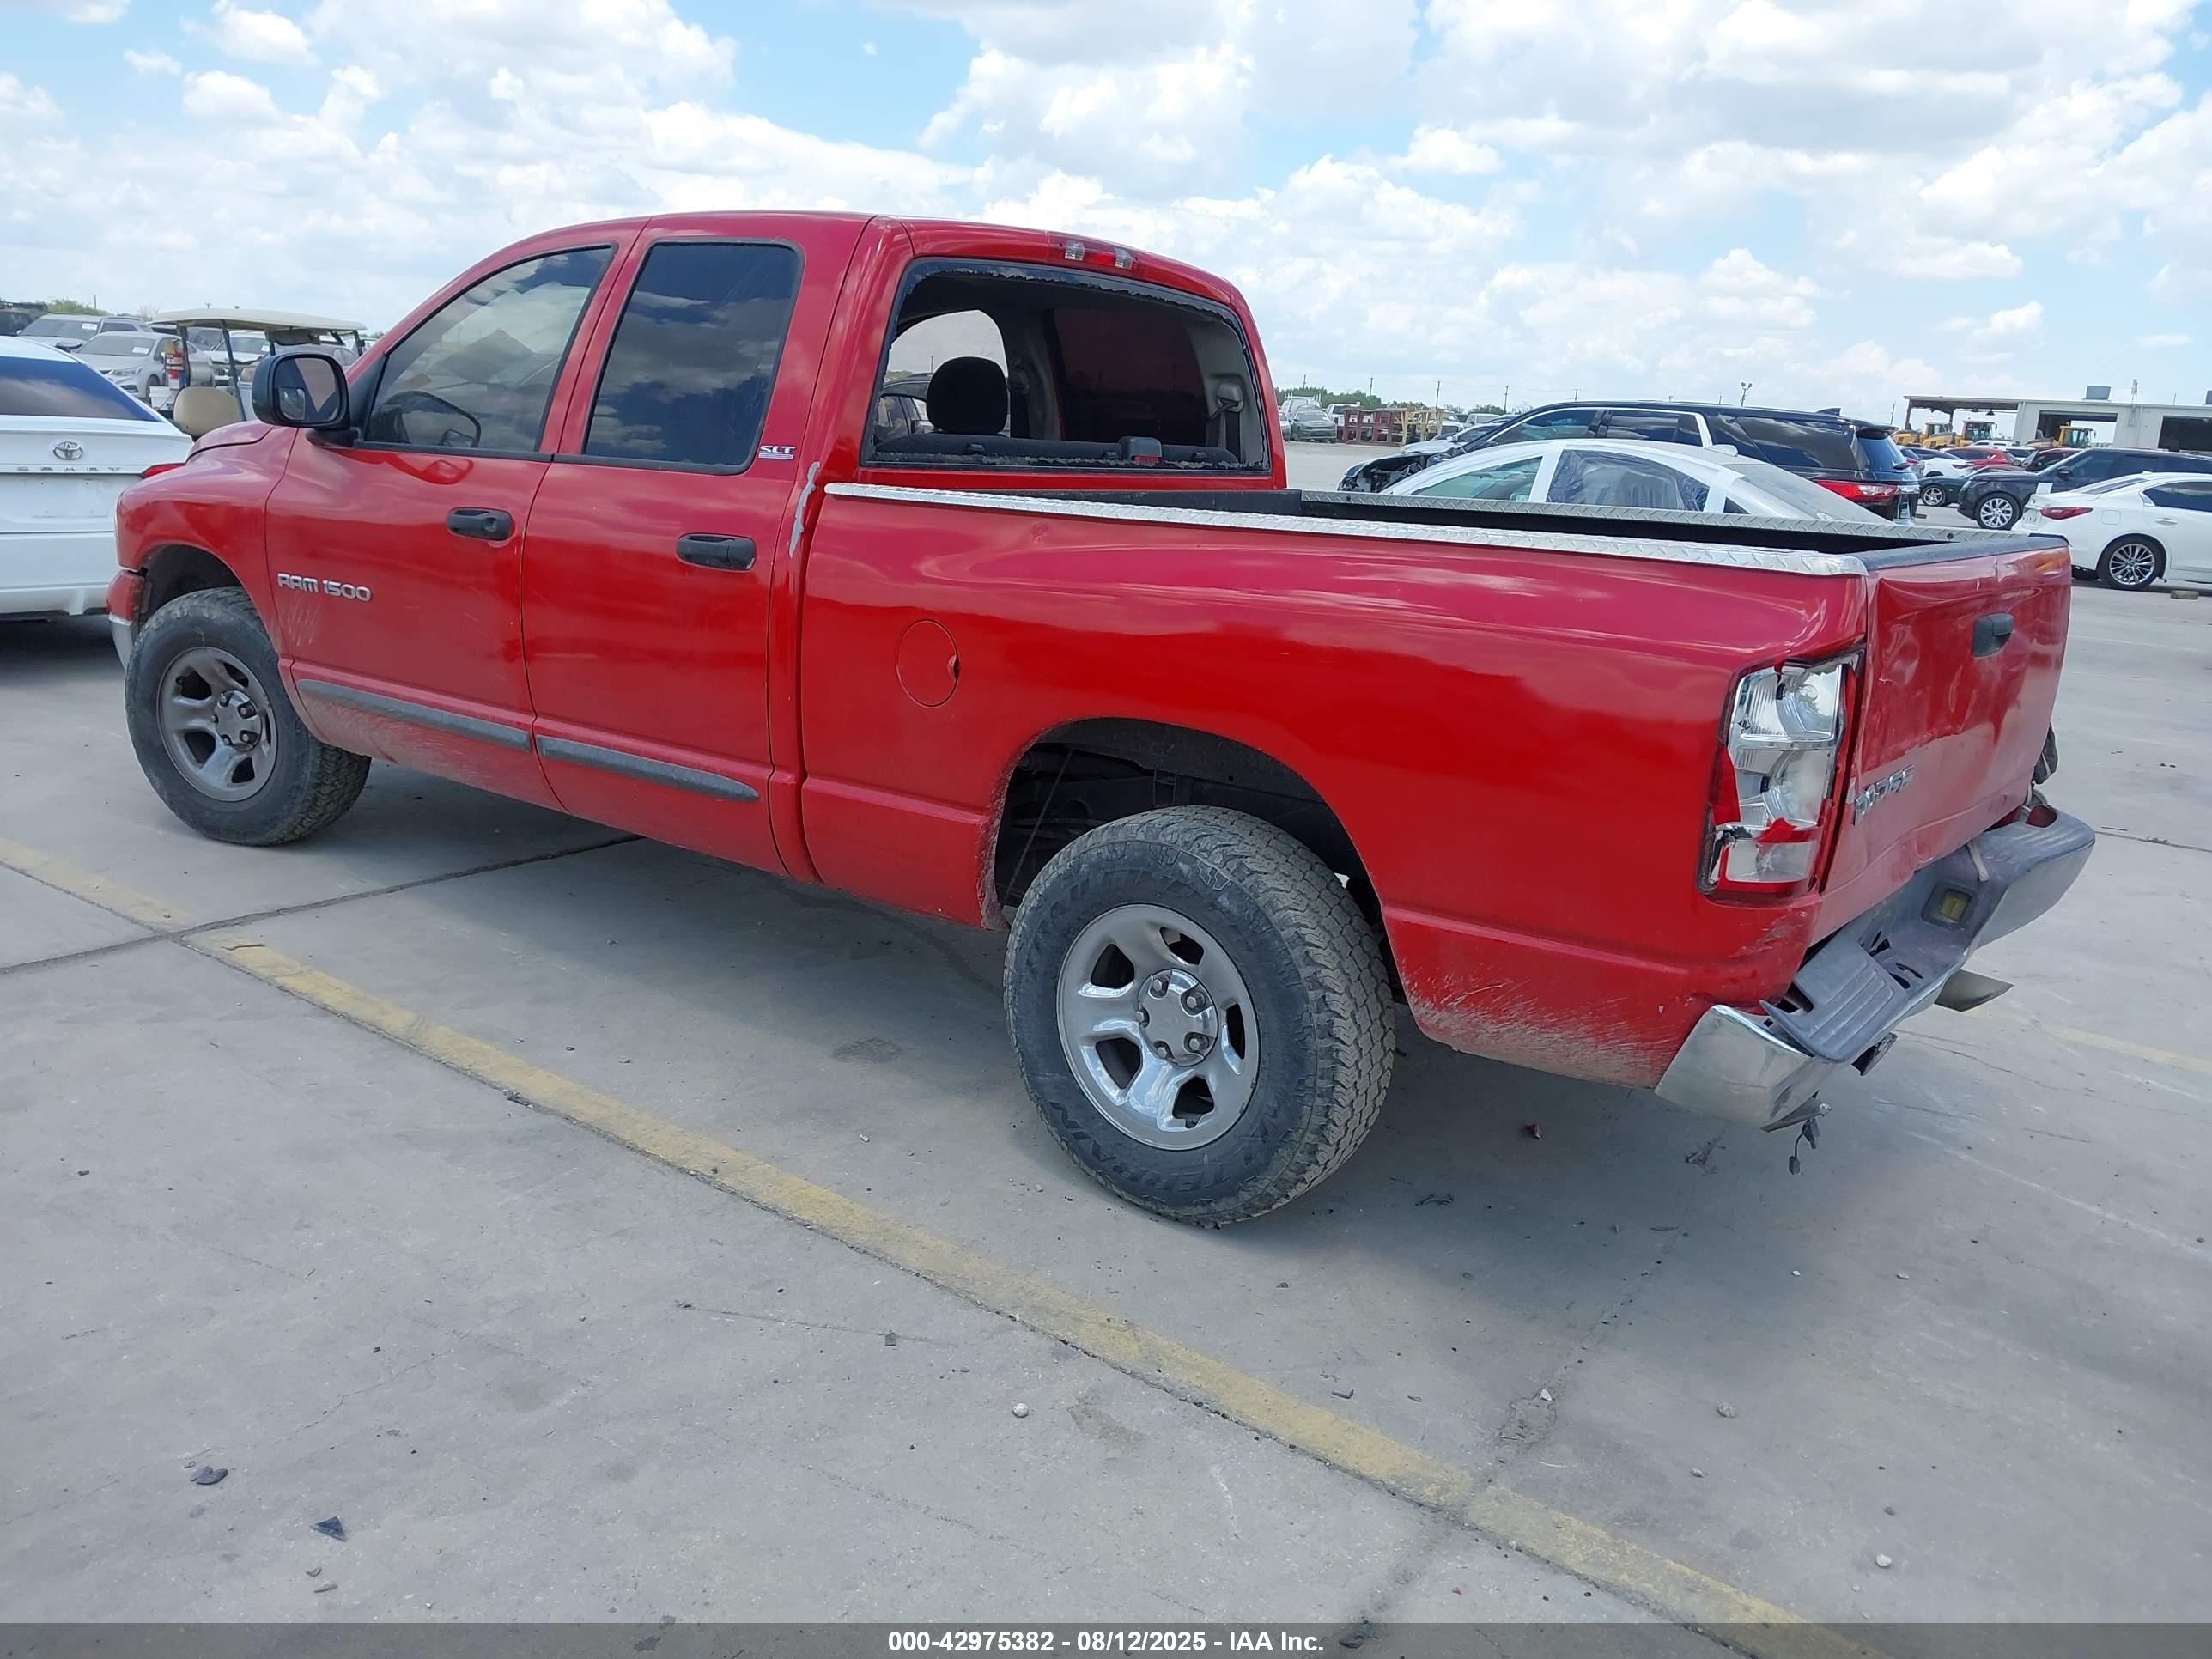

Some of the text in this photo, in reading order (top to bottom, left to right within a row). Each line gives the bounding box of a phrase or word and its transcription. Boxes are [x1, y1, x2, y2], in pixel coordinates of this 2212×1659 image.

[759, 445, 796, 455] SLT
[277, 572, 371, 602] RAM 1500
